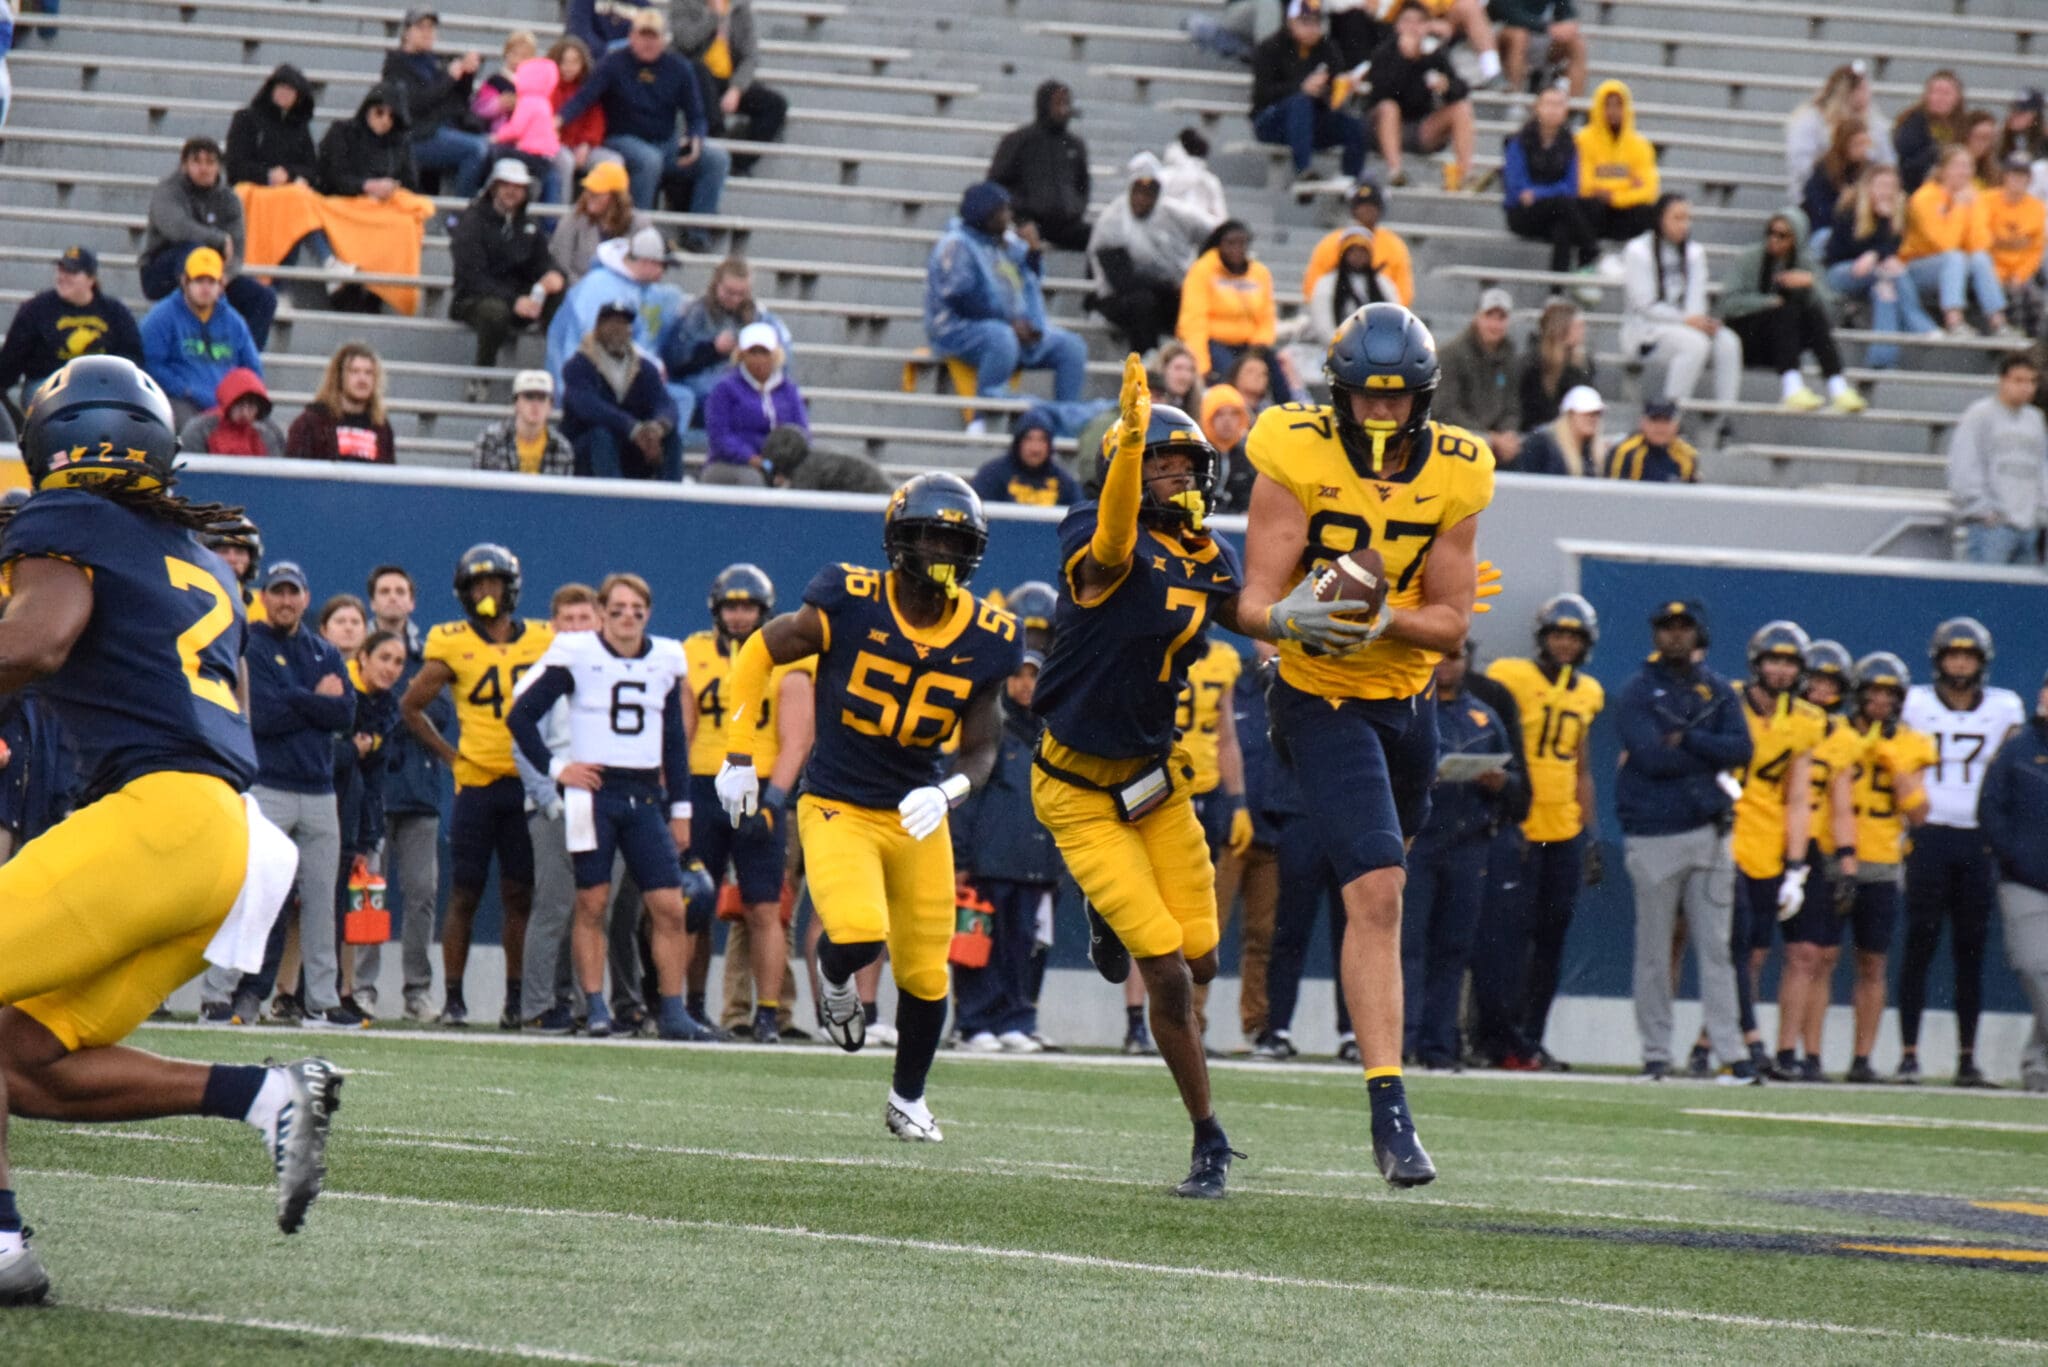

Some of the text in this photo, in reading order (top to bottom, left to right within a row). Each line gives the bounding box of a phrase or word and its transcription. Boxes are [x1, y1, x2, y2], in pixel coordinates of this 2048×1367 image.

[98, 442, 114, 463] 2
[164, 555, 241, 715] 2
[1157, 585, 1209, 683] 7
[468, 664, 535, 720] 4
[610, 680, 647, 736] 6
[841, 649, 974, 749] 56
[1537, 703, 1584, 761] 10
[1934, 732, 1986, 784] 17
